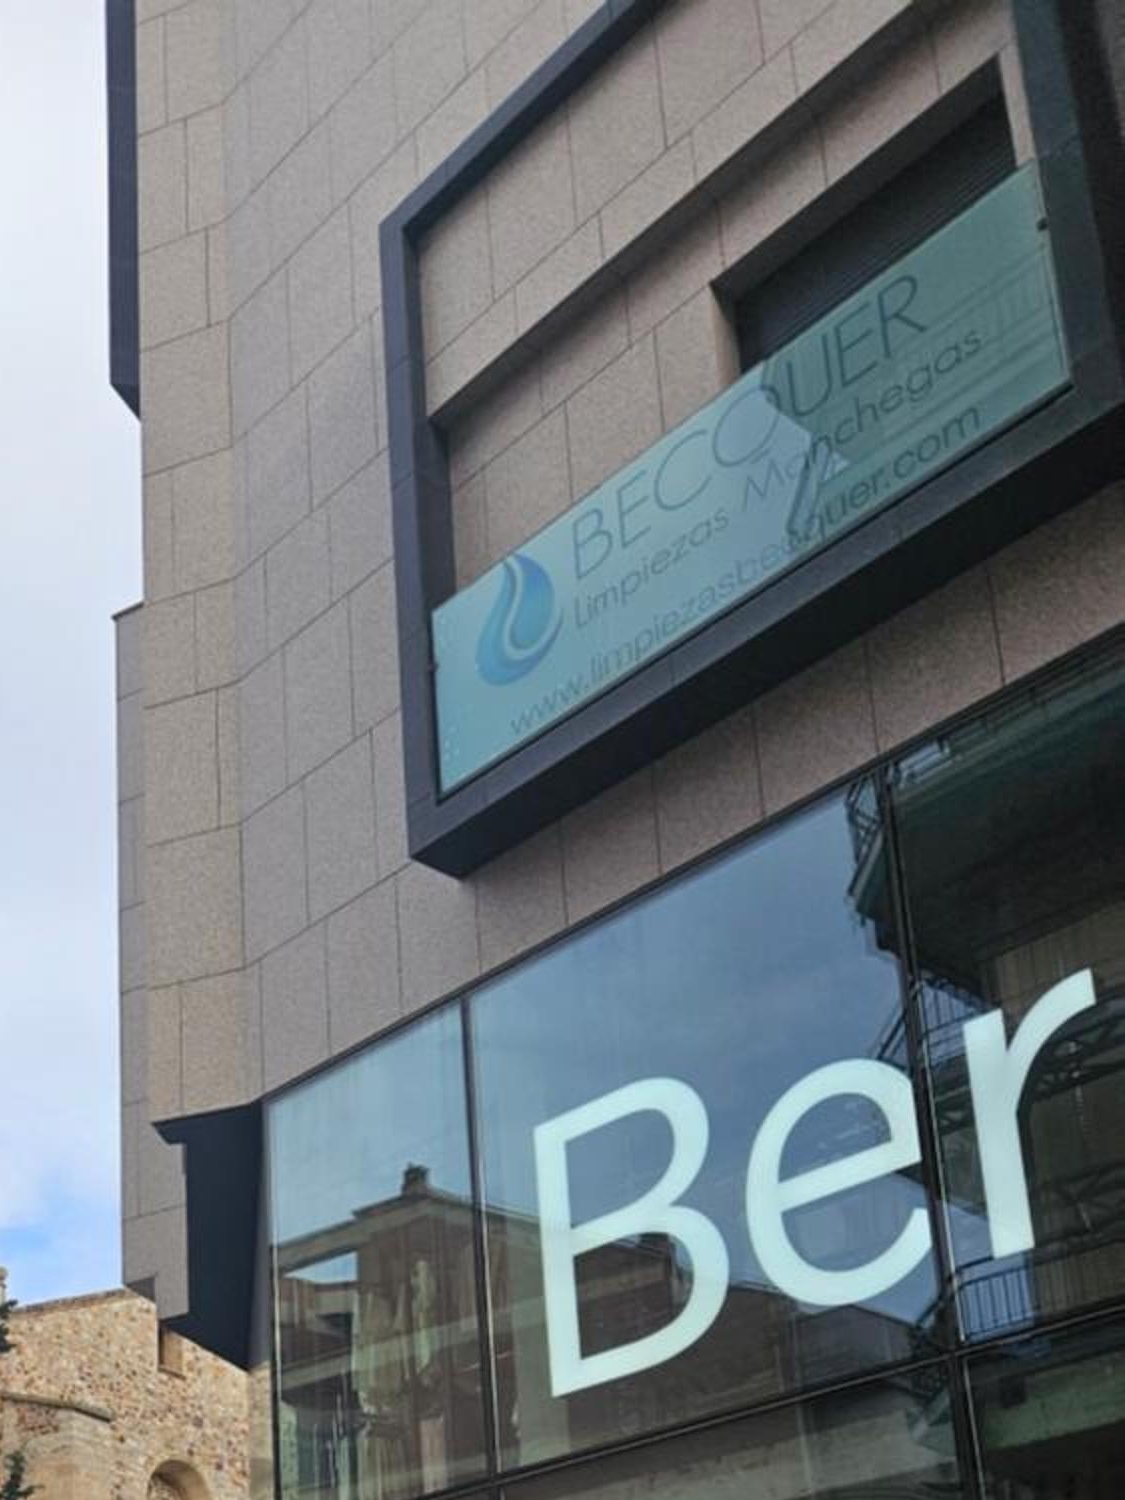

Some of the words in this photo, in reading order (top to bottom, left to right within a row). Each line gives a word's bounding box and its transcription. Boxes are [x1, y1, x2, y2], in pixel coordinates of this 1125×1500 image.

[571, 274, 928, 581] BECQUER
[573, 506, 731, 630] Limpiezas
[741, 328, 983, 513] Manchegas
[533, 967, 1097, 1398] Ber
